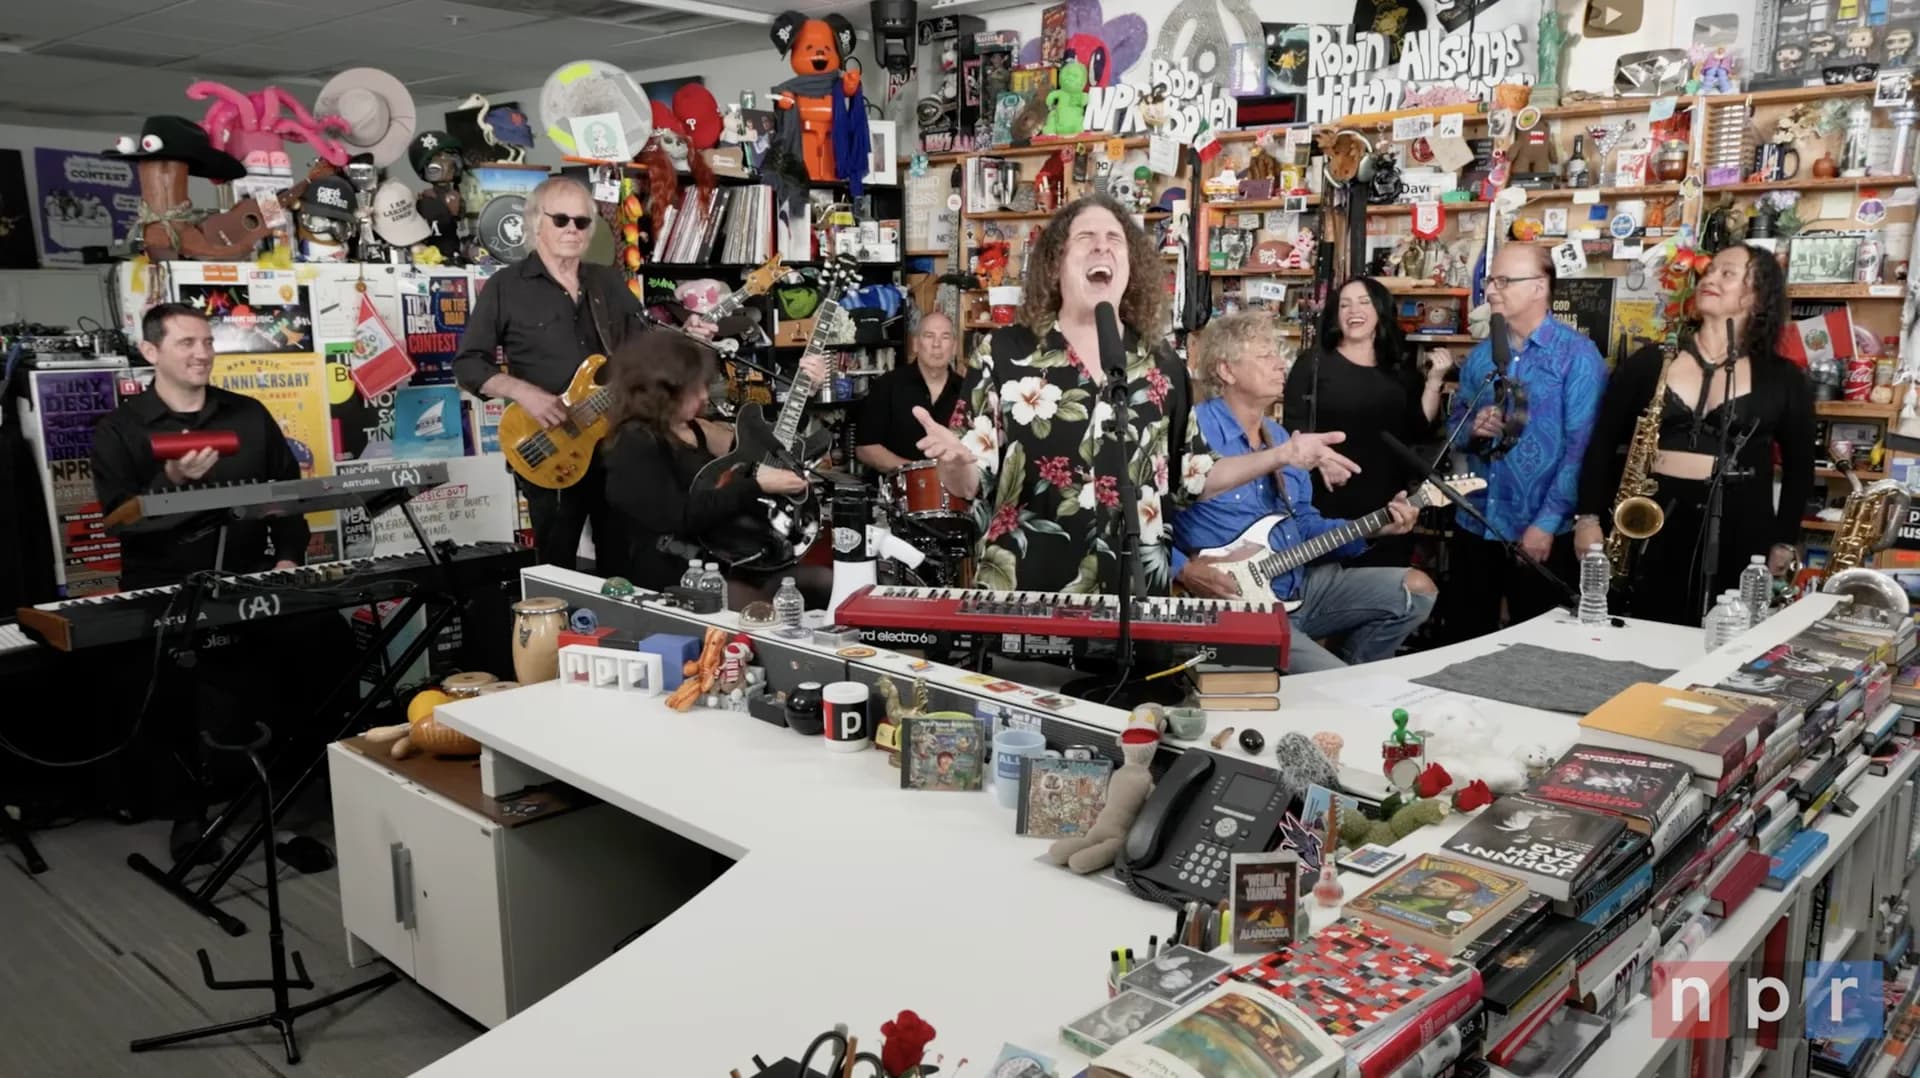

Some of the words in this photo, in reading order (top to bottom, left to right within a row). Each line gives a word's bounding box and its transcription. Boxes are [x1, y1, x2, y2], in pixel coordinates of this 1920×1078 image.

[1308, 25, 1383, 77] Robin
[1153, 57, 1199, 99] Bob
[1083, 84, 1148, 134] NPR
[1307, 75, 1400, 123] Hilton
[1163, 80, 1238, 144] Boilen
[70, 170, 129, 182] CONTEST
[405, 296, 431, 315] TINY
[408, 334, 456, 352] CONTEST
[223, 373, 310, 390] ANNIVERSARY
[46, 394, 108, 411] DESK
[53, 461, 91, 481] NPR
[342, 478, 381, 488] ARTURIA
[877, 631, 919, 645] electro
[1453, 842, 1573, 877] JOHNNY
[1505, 845, 1578, 869] CASH
[1530, 843, 1586, 863] FAQ
